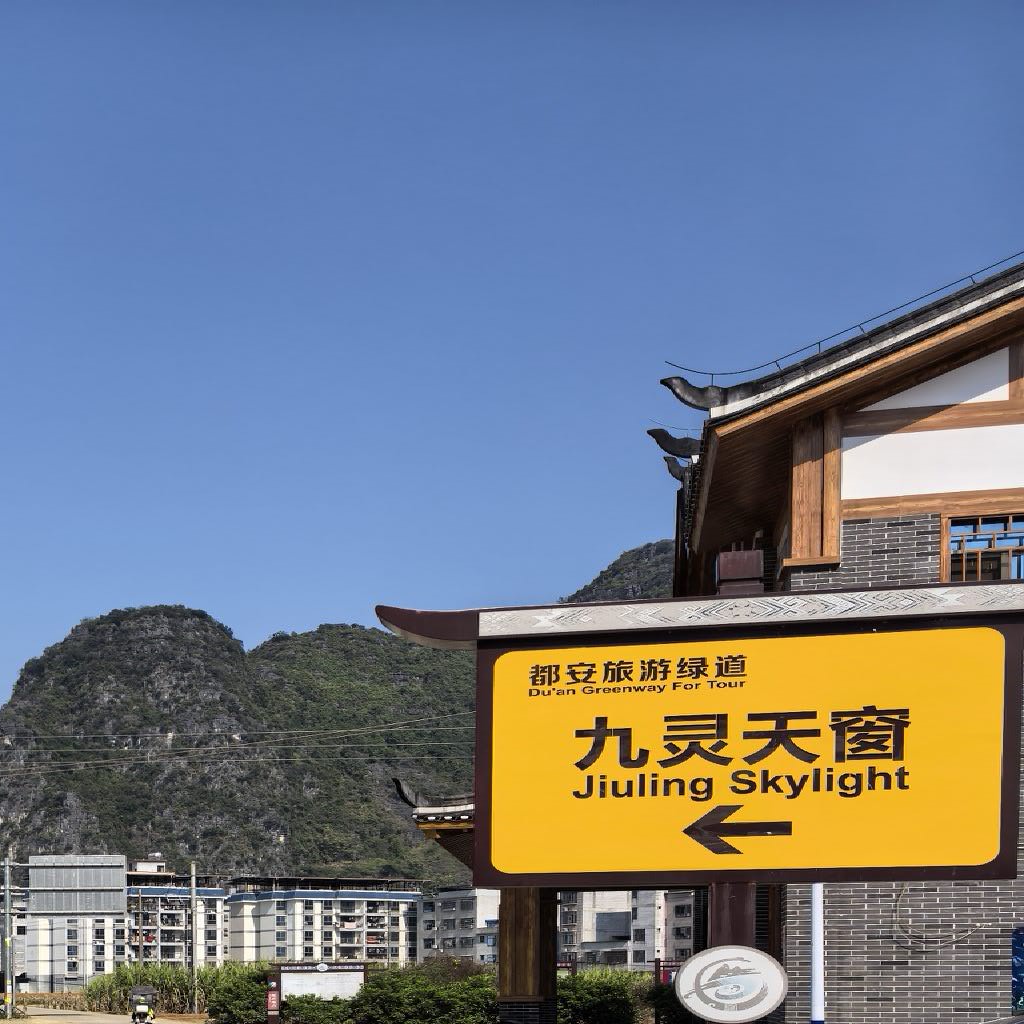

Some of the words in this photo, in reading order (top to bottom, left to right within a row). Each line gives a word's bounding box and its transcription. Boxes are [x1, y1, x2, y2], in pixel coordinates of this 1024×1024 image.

[528, 654, 747, 686] 都安旅游绿道
[528, 687, 576, 697] Du'an
[581, 683, 667, 695] Greenway
[672, 681, 701, 691] For
[707, 679, 745, 689] Tour
[574, 705, 911, 771] 九灵天窗
[573, 773, 714, 802] Jiuling
[729, 766, 909, 800] Skylight
